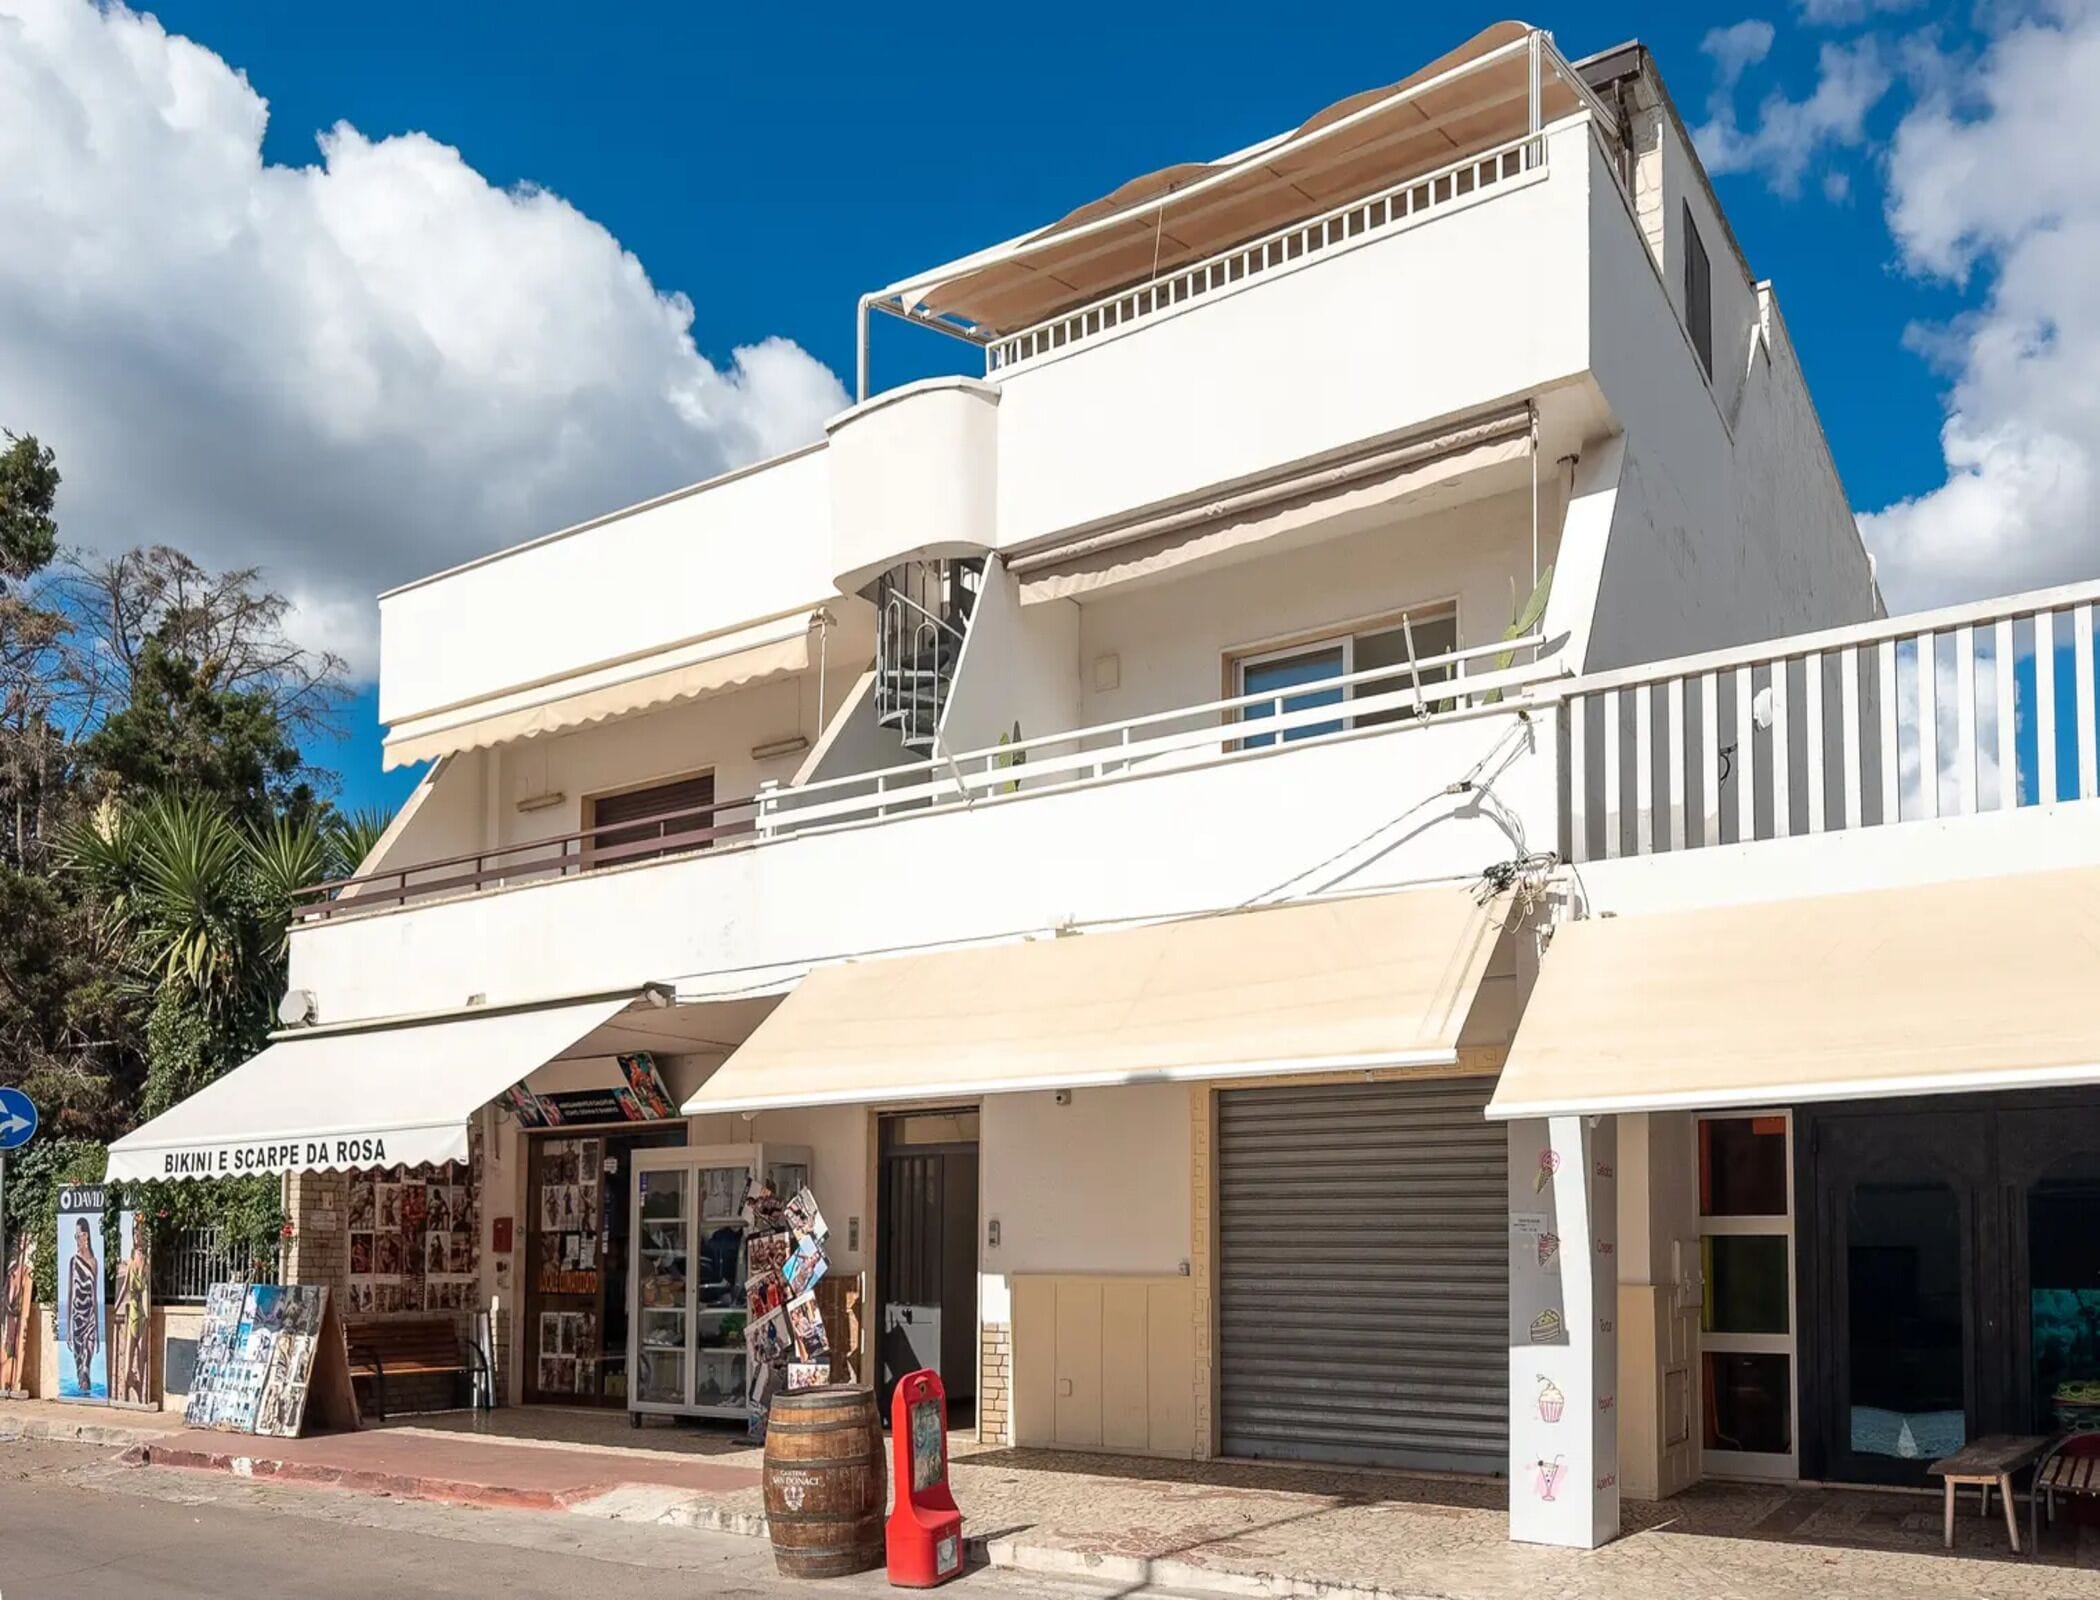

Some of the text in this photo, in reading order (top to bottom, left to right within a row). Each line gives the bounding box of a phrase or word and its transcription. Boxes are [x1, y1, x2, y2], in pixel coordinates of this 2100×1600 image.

[165, 1138, 386, 1173] BIKINI E SCARPE DA ROSA
[73, 1190, 105, 1208] DAVID
